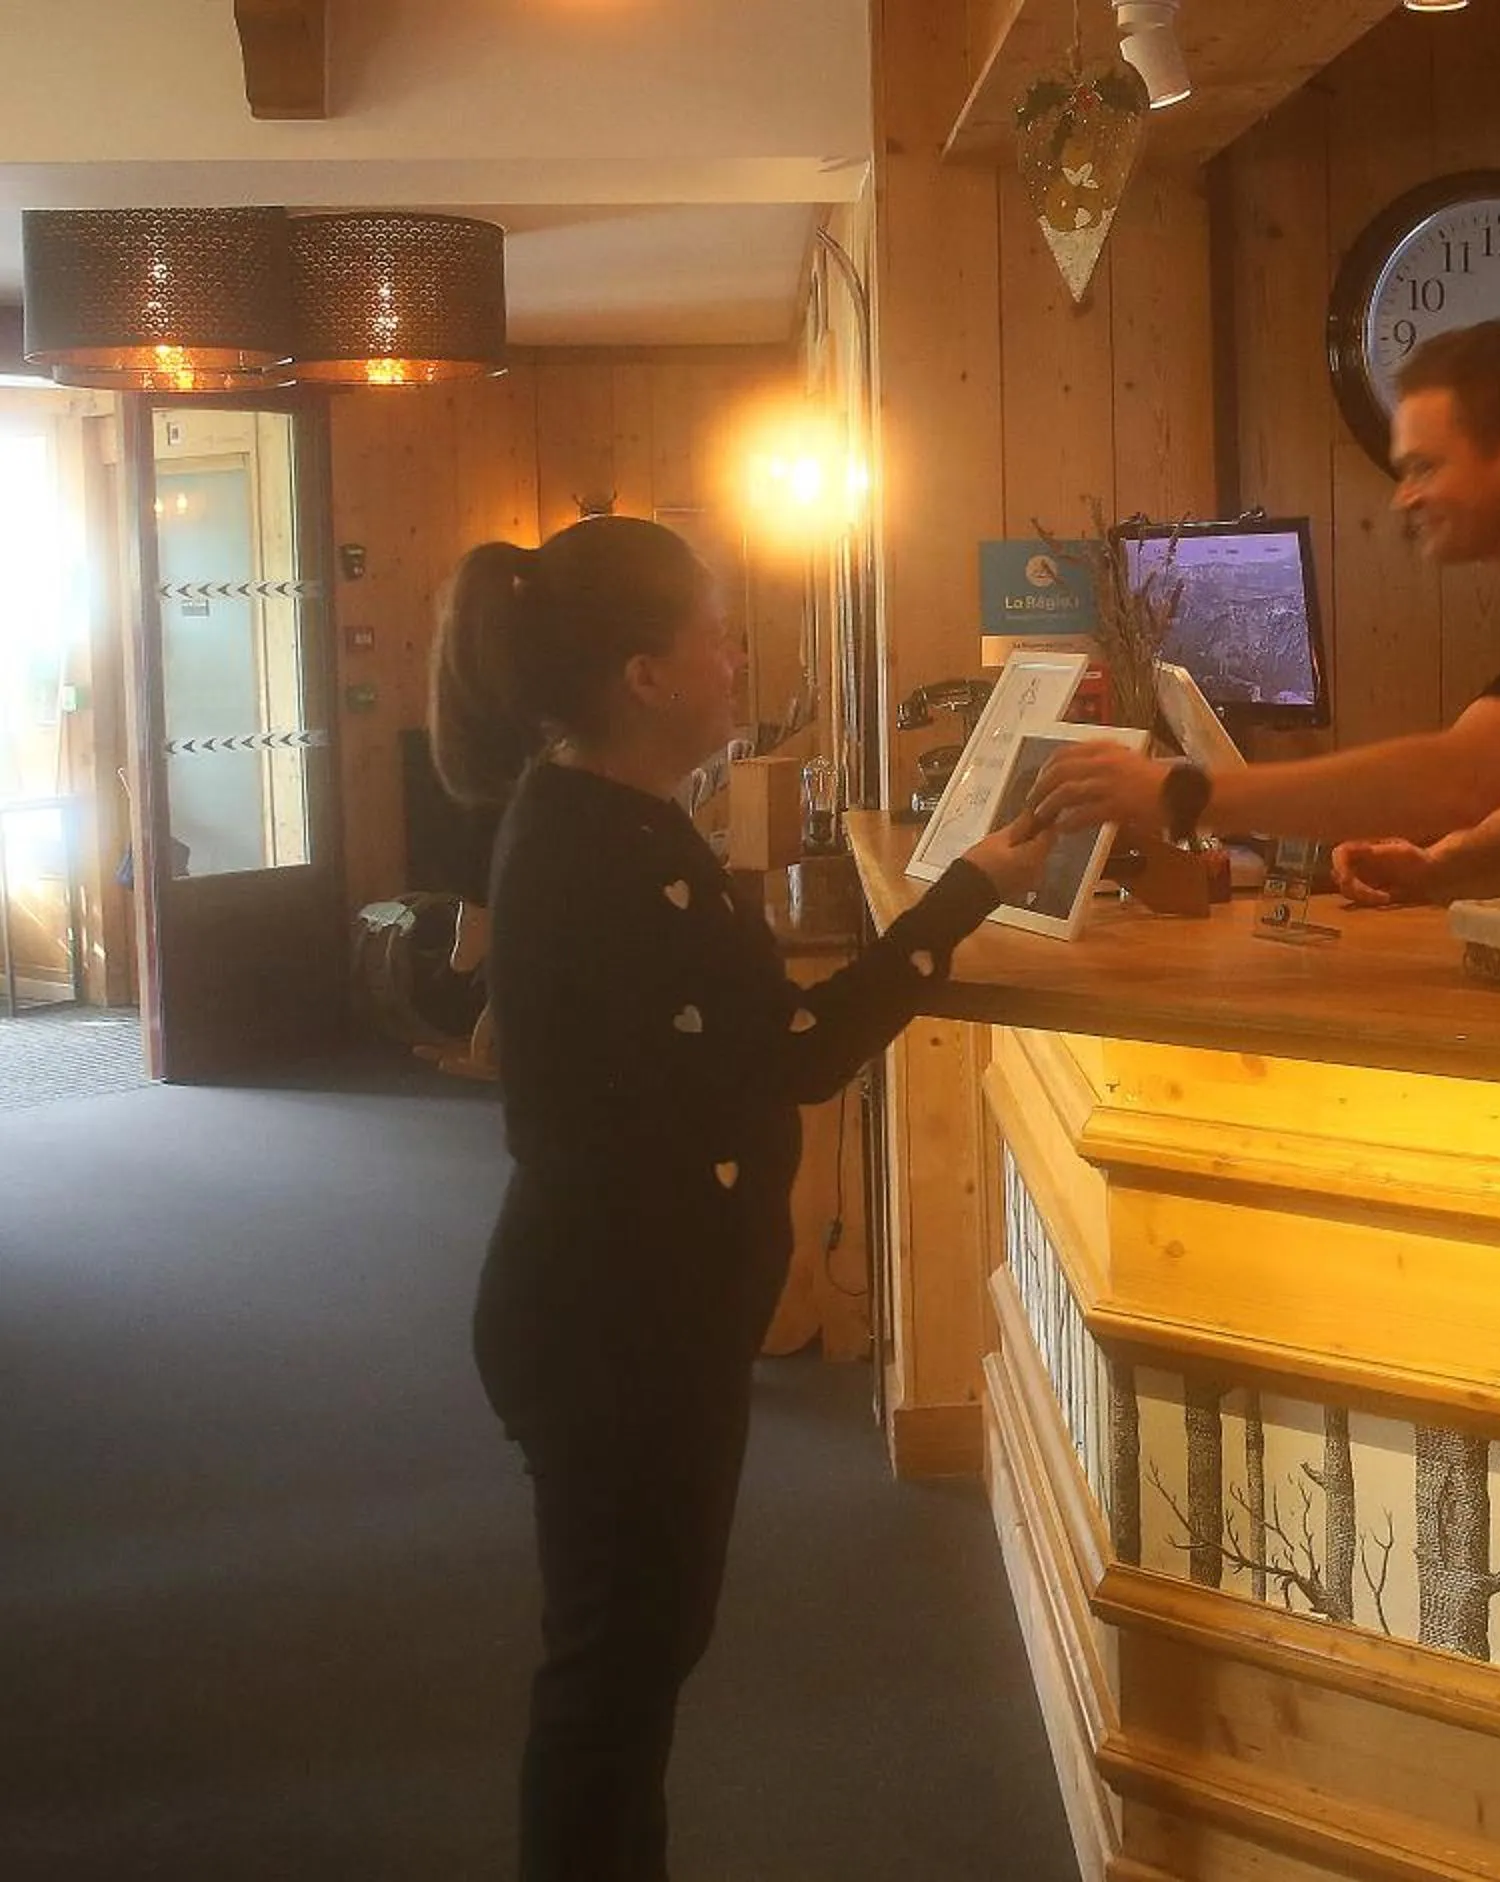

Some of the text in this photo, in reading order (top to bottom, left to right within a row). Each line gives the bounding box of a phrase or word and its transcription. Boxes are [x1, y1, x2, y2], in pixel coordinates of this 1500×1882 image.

[1442, 241, 1472, 273] 11
[1408, 278, 1445, 313] 10
[1393, 320, 1417, 357] 9
[1004, 595, 1024, 610] La
